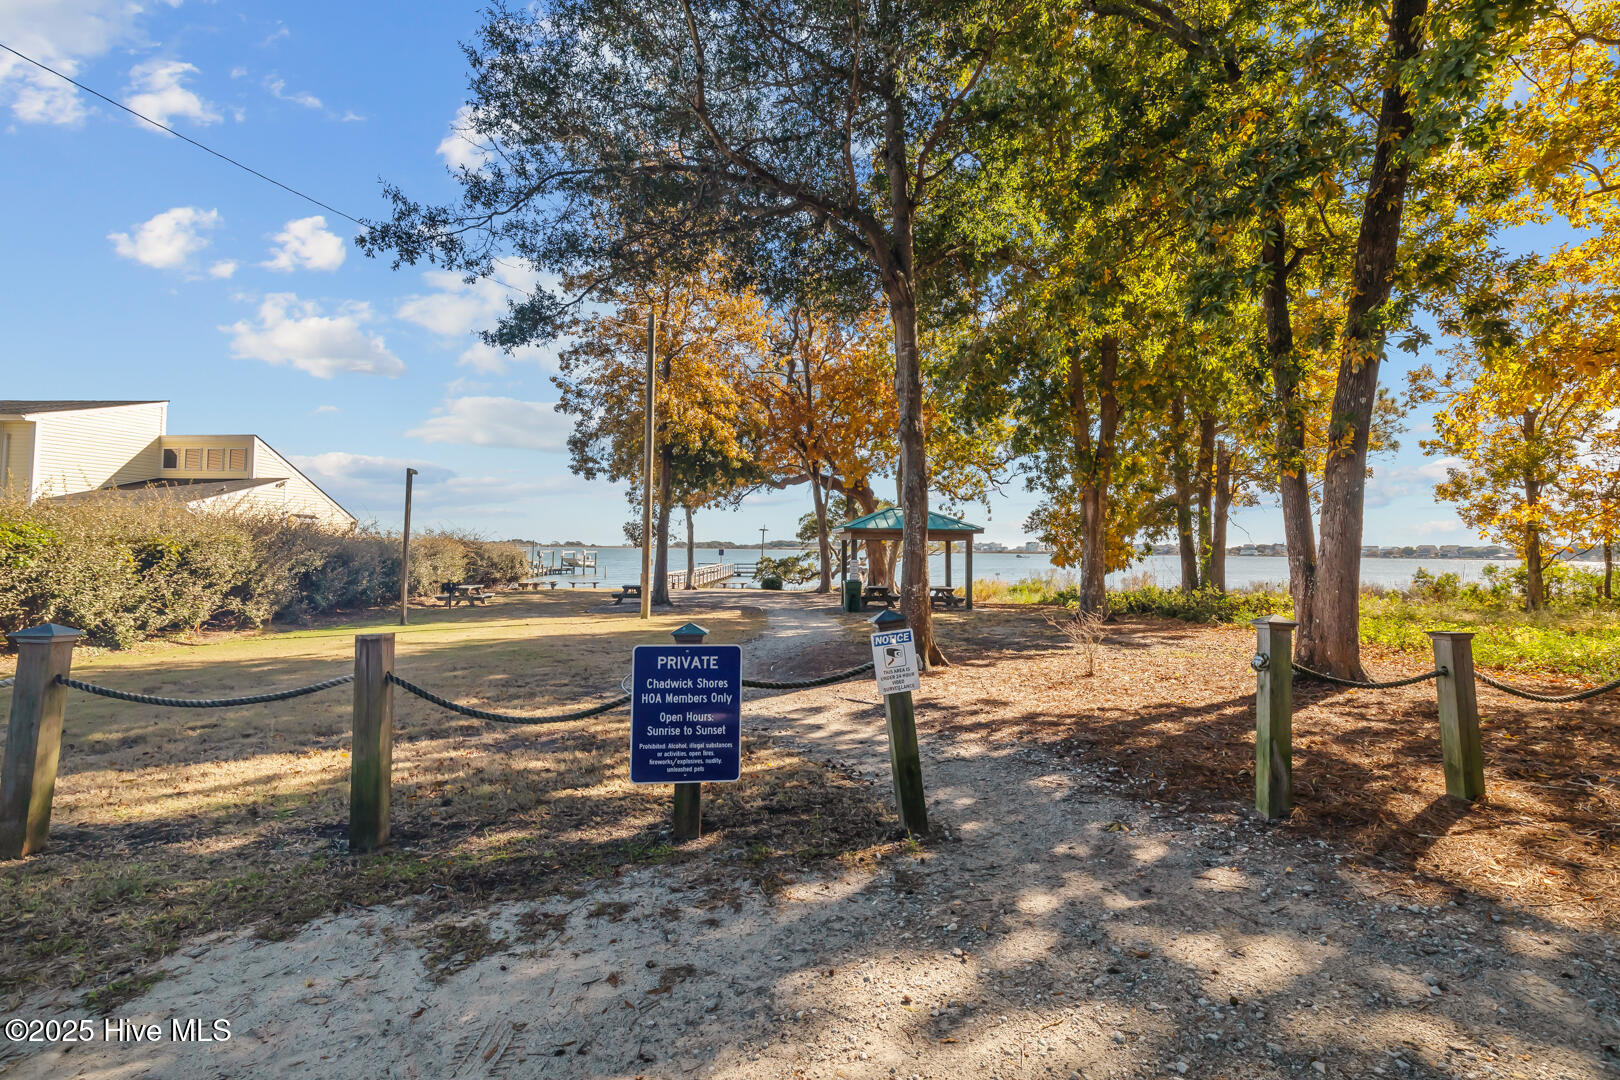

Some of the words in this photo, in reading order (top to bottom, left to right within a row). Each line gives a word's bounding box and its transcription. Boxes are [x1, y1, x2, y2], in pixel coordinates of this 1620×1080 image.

[876, 632, 910, 645] NOTICE
[657, 656, 719, 669] PRIVATE
[646, 678, 694, 689] Chadwick
[696, 678, 728, 688] Shores
[883, 684, 915, 692] SURVEILLANCE
[641, 693, 662, 704] HOA
[666, 692, 708, 704] Members
[711, 692, 733, 705] Only
[660, 712, 683, 724] Open
[686, 712, 714, 722] Hours:
[647, 726, 680, 736] Sunrise
[684, 726, 692, 736] to
[696, 724, 726, 735] Sunset
